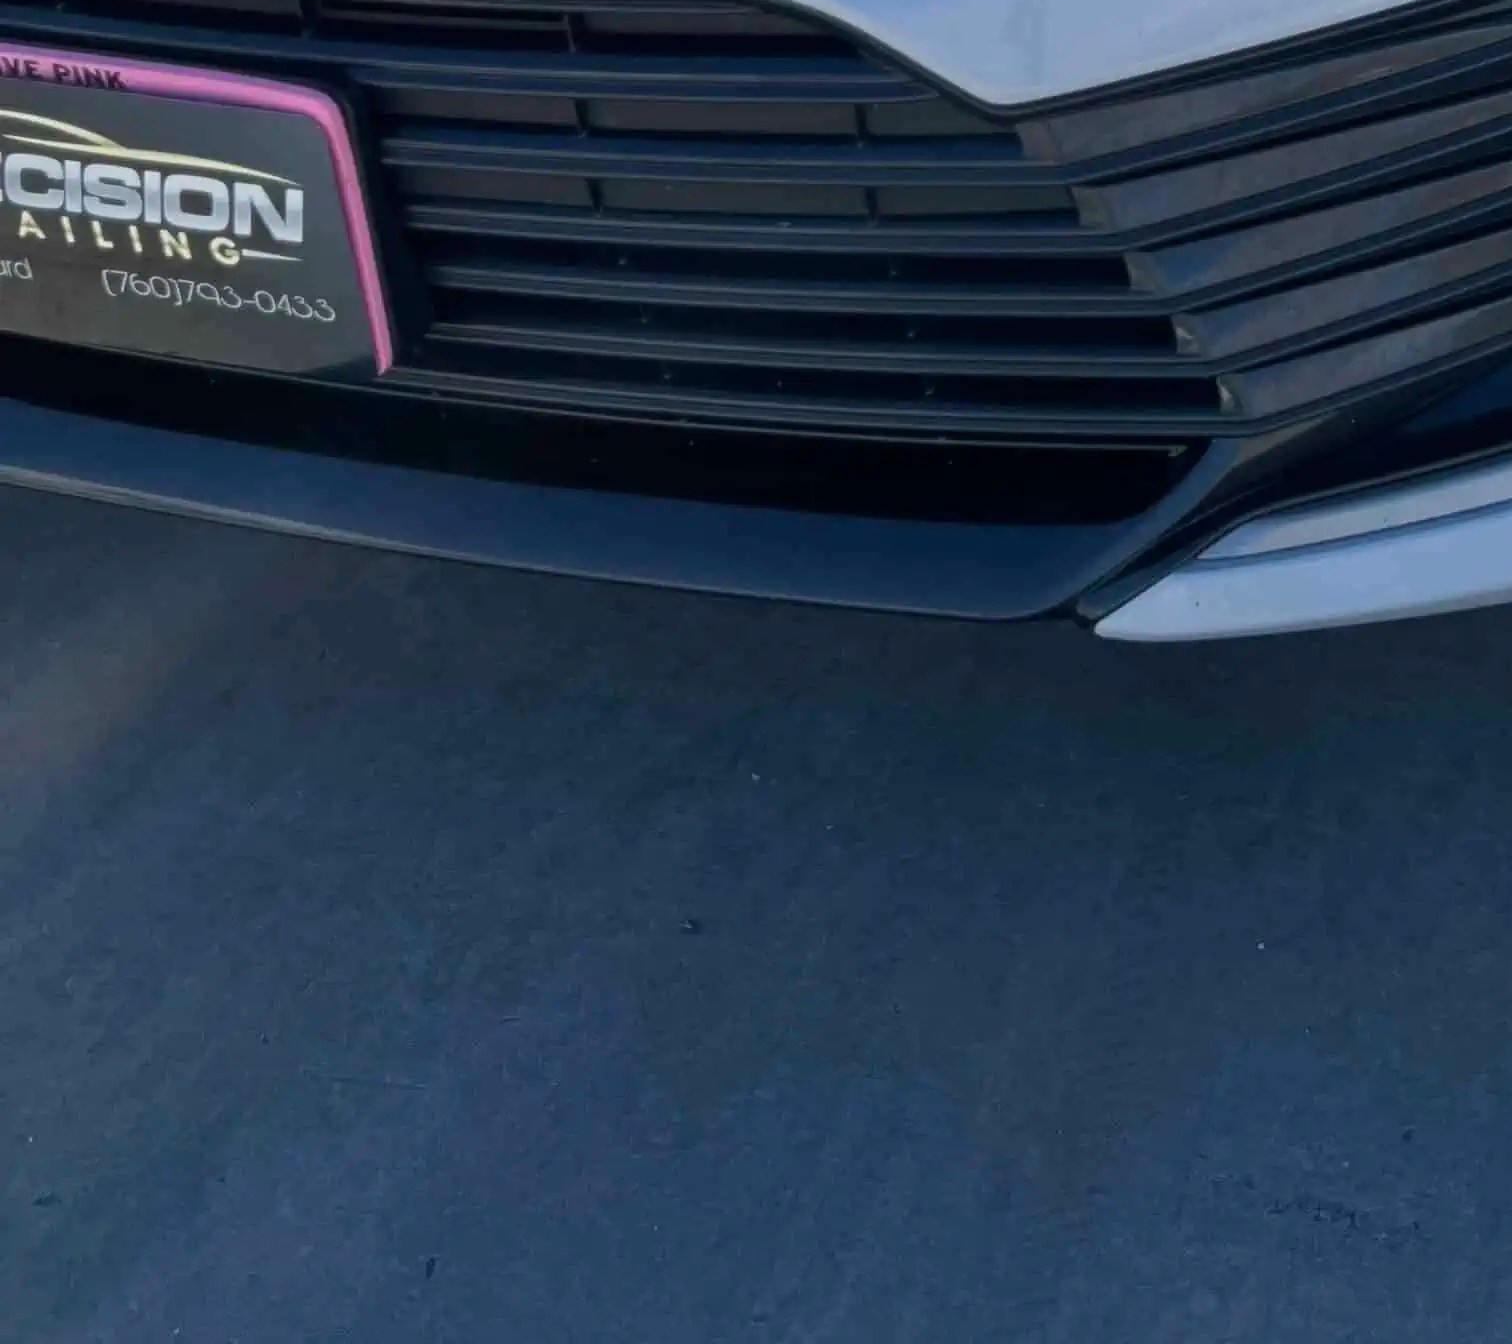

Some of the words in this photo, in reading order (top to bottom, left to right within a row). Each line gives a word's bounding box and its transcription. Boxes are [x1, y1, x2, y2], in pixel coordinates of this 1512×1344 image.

[0, 55, 40, 78] VE
[53, 62, 128, 88] PINK
[0, 153, 303, 242] CISION
